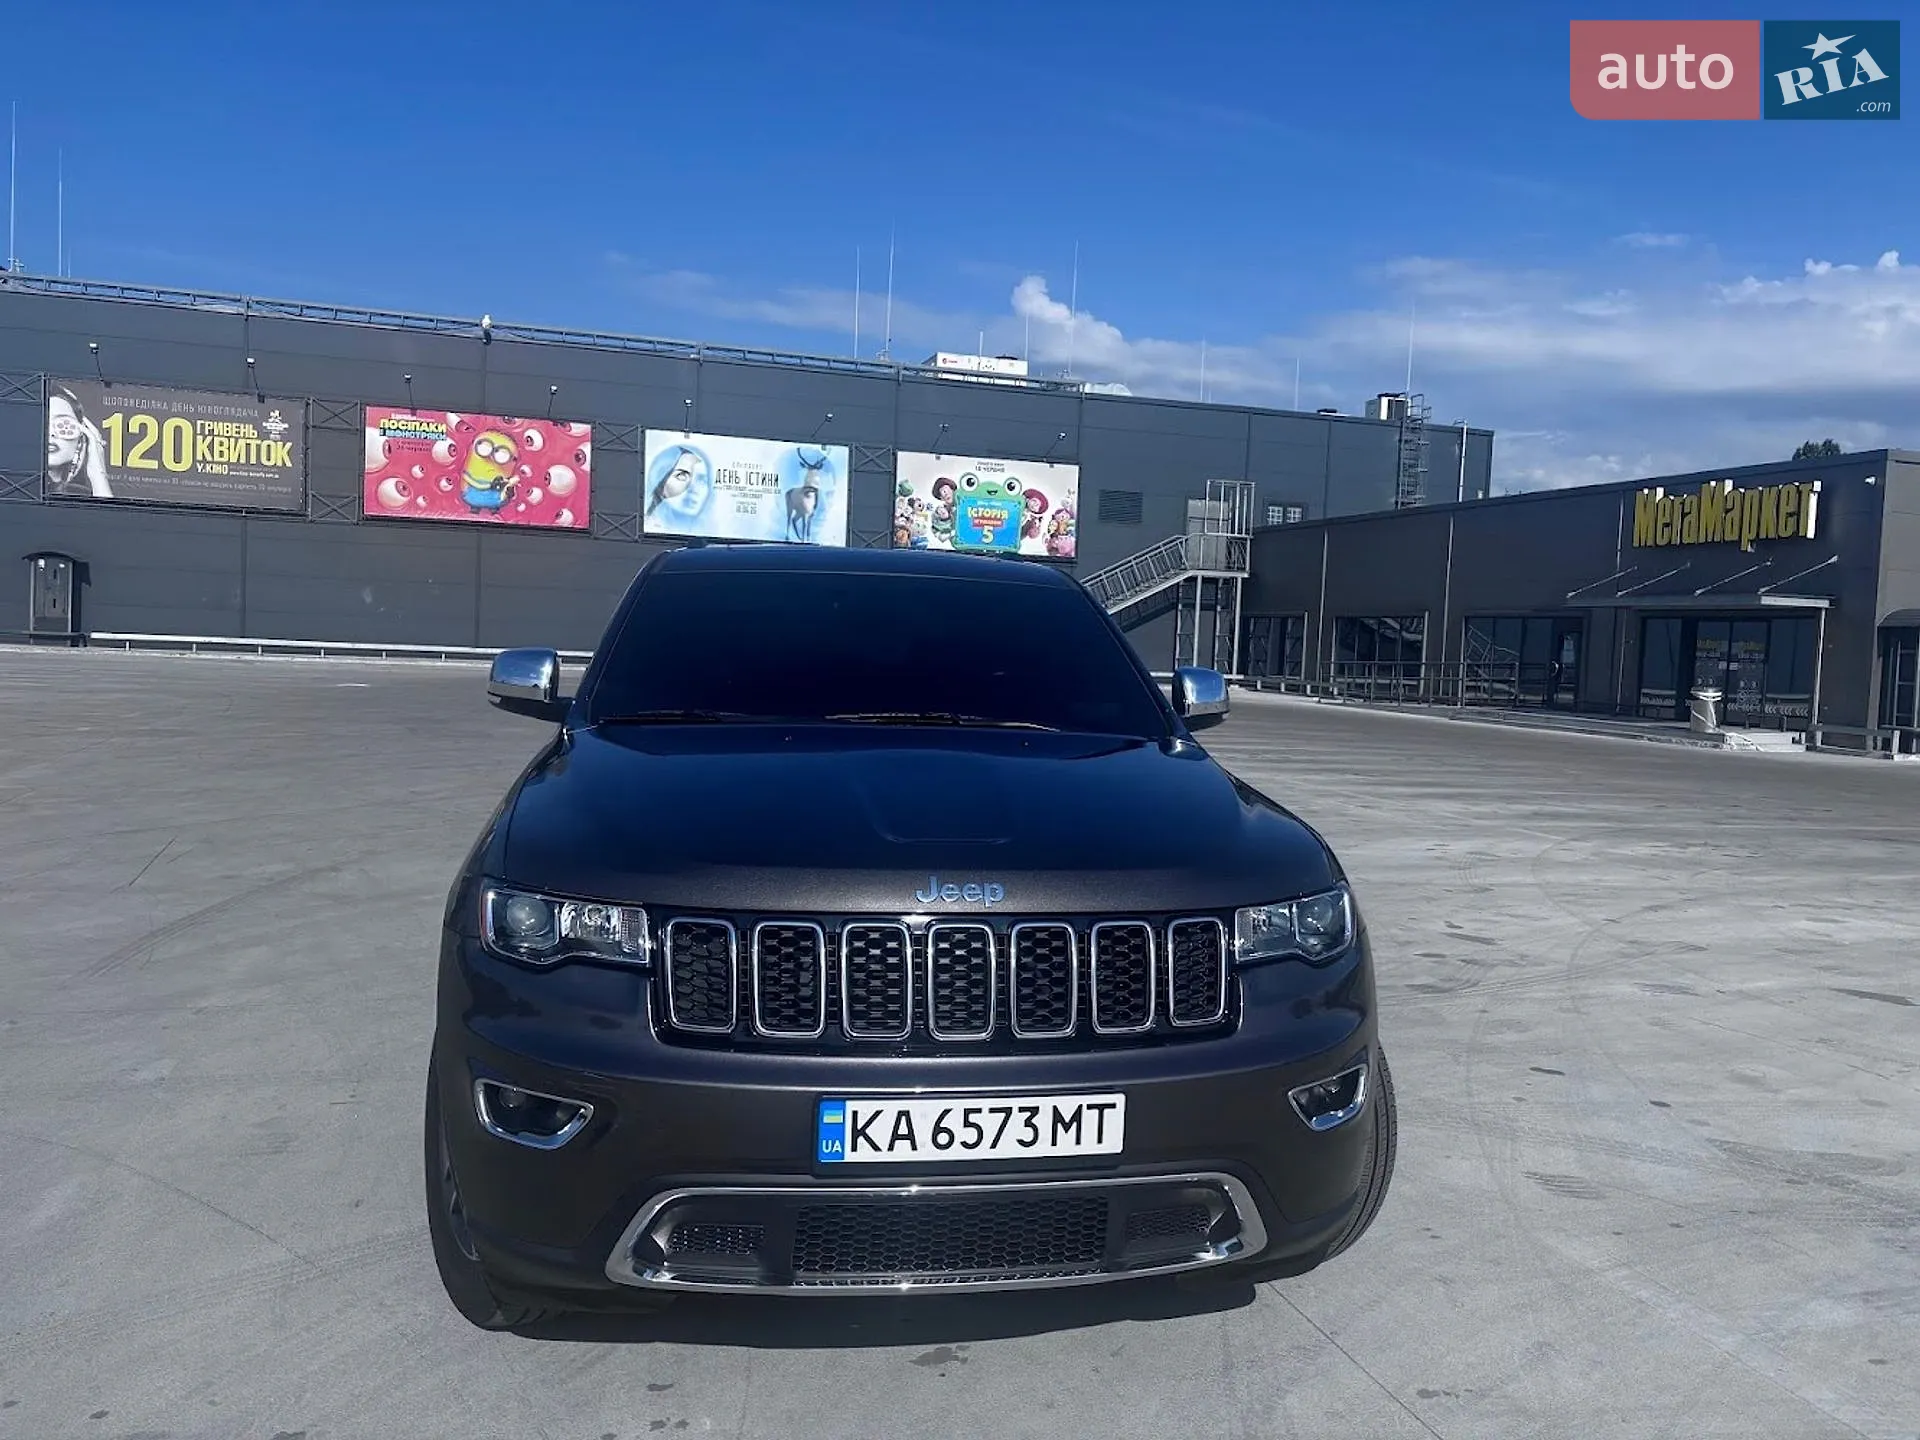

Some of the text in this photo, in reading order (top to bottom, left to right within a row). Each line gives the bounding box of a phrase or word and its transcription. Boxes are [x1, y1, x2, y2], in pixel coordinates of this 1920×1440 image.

[171, 402, 195, 413] ДЕНЬ
[196, 420, 258, 438] ГРИВЕНЬ
[102, 412, 194, 472] 120
[196, 435, 293, 467] КВИТОК
[716, 468, 779, 488] ДЕНЬ ІСТИНИ
[967, 505, 1009, 520] ІСТОРІЯ
[1632, 479, 1822, 552] МегаМаркет
[981, 525, 994, 544] 5
[915, 875, 1005, 908] Jeep
[850, 1102, 1117, 1152] KA 6573 MT
[822, 1140, 842, 1153] UA
